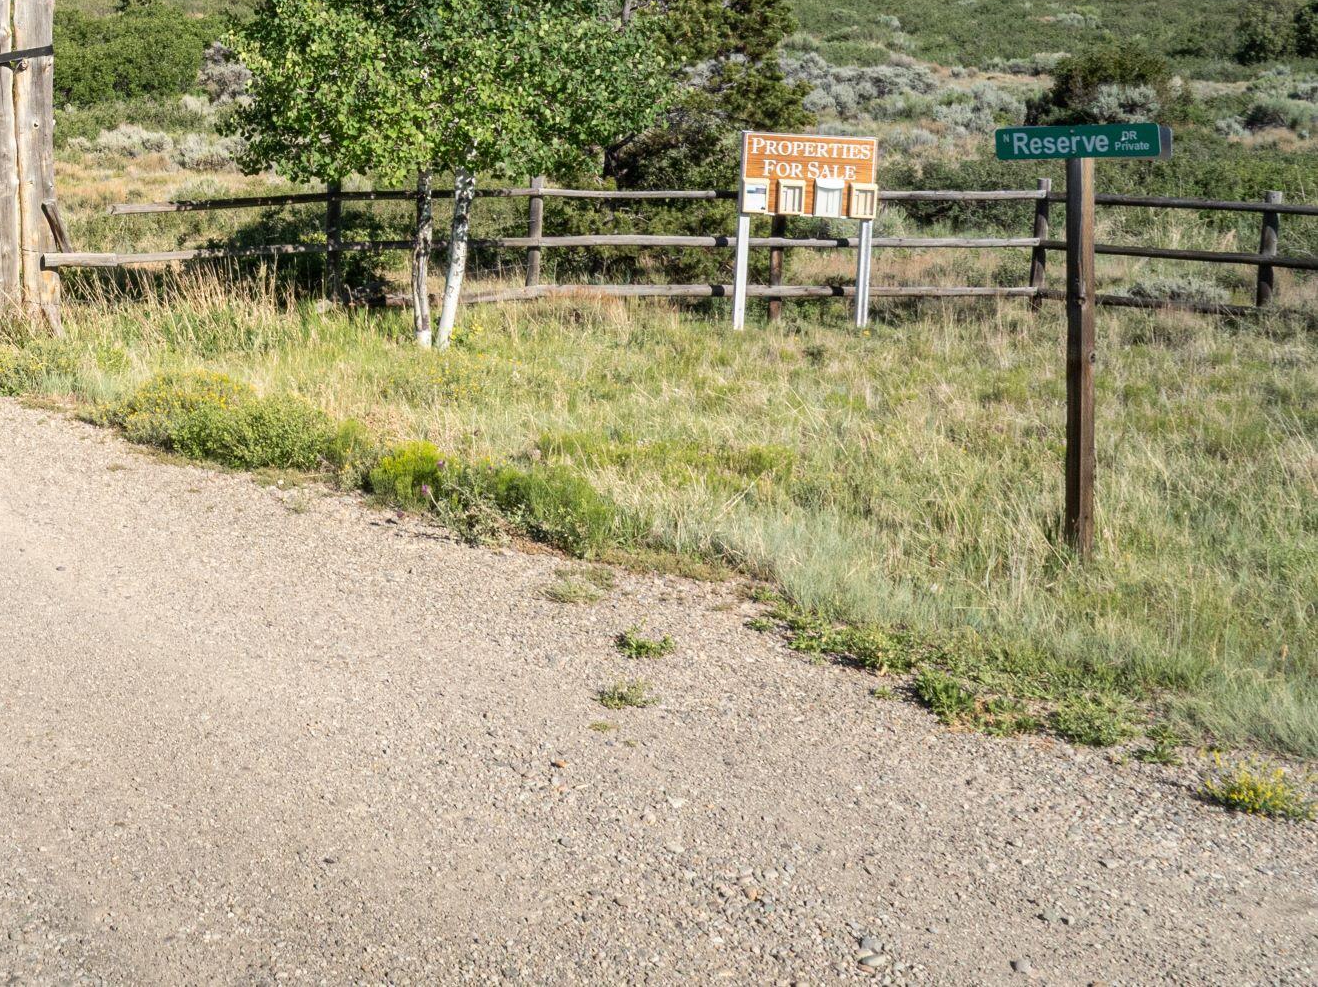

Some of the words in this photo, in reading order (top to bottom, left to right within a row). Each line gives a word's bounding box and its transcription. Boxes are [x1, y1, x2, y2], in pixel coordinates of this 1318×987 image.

[751, 137, 871, 160] PROPERTIES
[1012, 132, 1109, 154] Reserve
[1121, 131, 1138, 141] DR
[1114, 141, 1150, 151] Private
[763, 160, 803, 178] FOR
[807, 161, 857, 181] SALE
